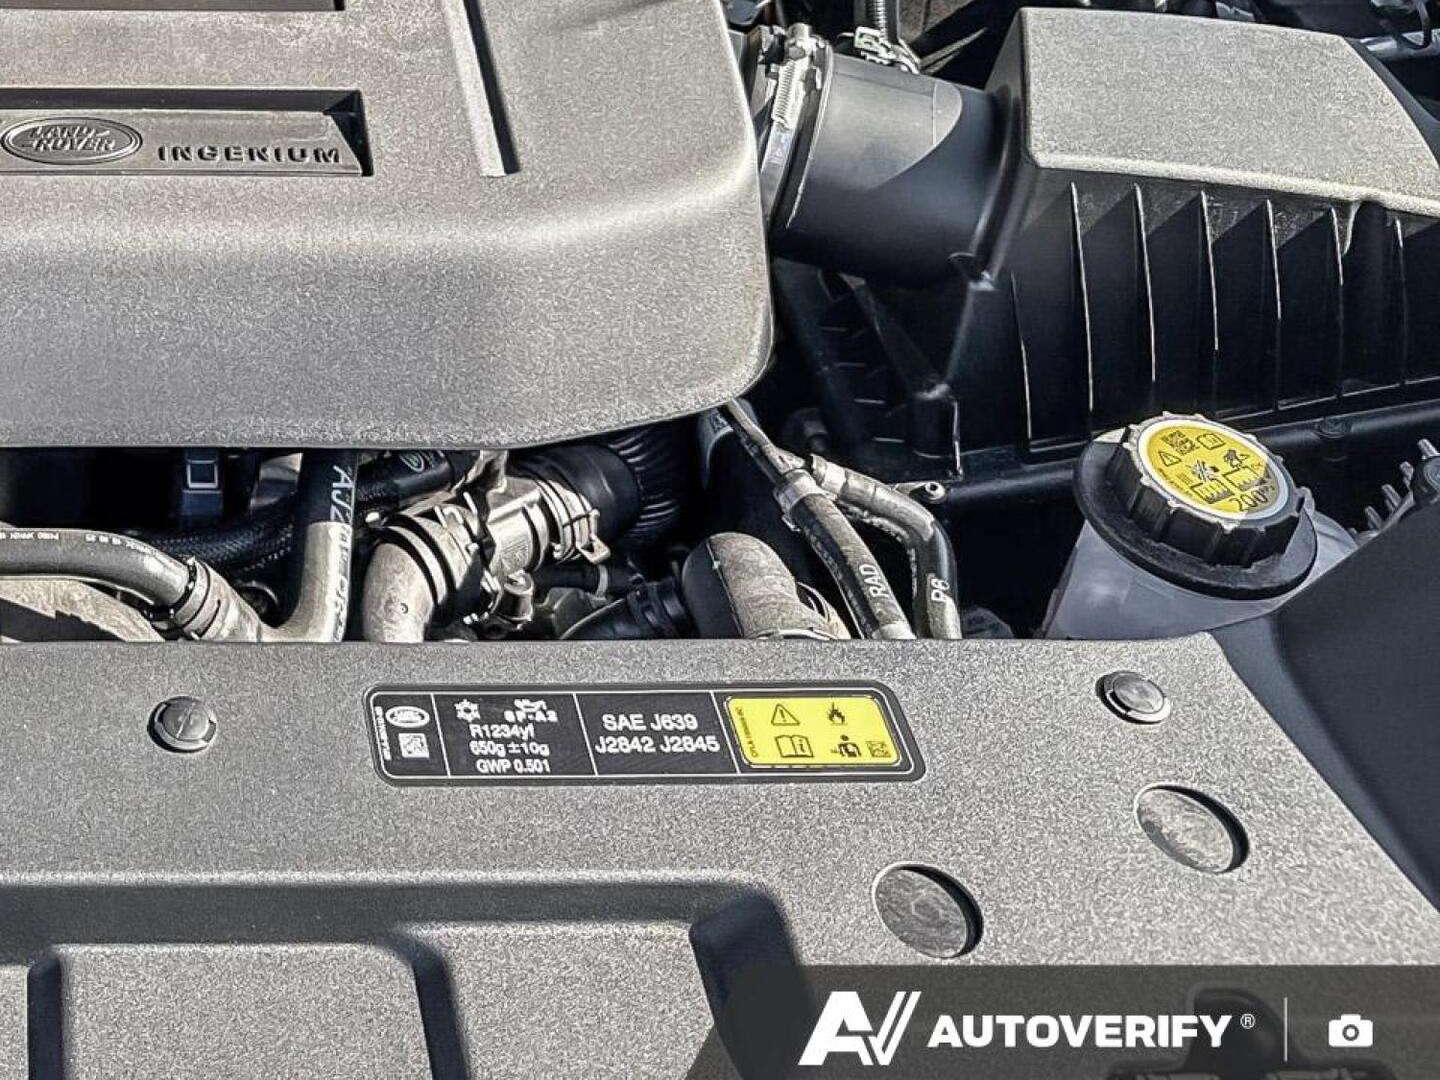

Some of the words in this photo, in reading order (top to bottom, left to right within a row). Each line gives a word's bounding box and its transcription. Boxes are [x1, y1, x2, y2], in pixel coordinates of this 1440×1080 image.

[29, 125, 97, 139] LAND
[32, 137, 117, 152] ROVER
[157, 145, 344, 164] INGENIUM
[858, 563, 890, 599] RAD
[468, 722, 535, 740] R1234yf
[602, 713, 647, 731] SAE
[650, 713, 699, 731] J639
[468, 740, 507, 758] 650g
[594, 735, 657, 754] J2842
[659, 735, 721, 753] J2845
[476, 758, 512, 774] GWP
[513, 758, 551, 774] 0.501
